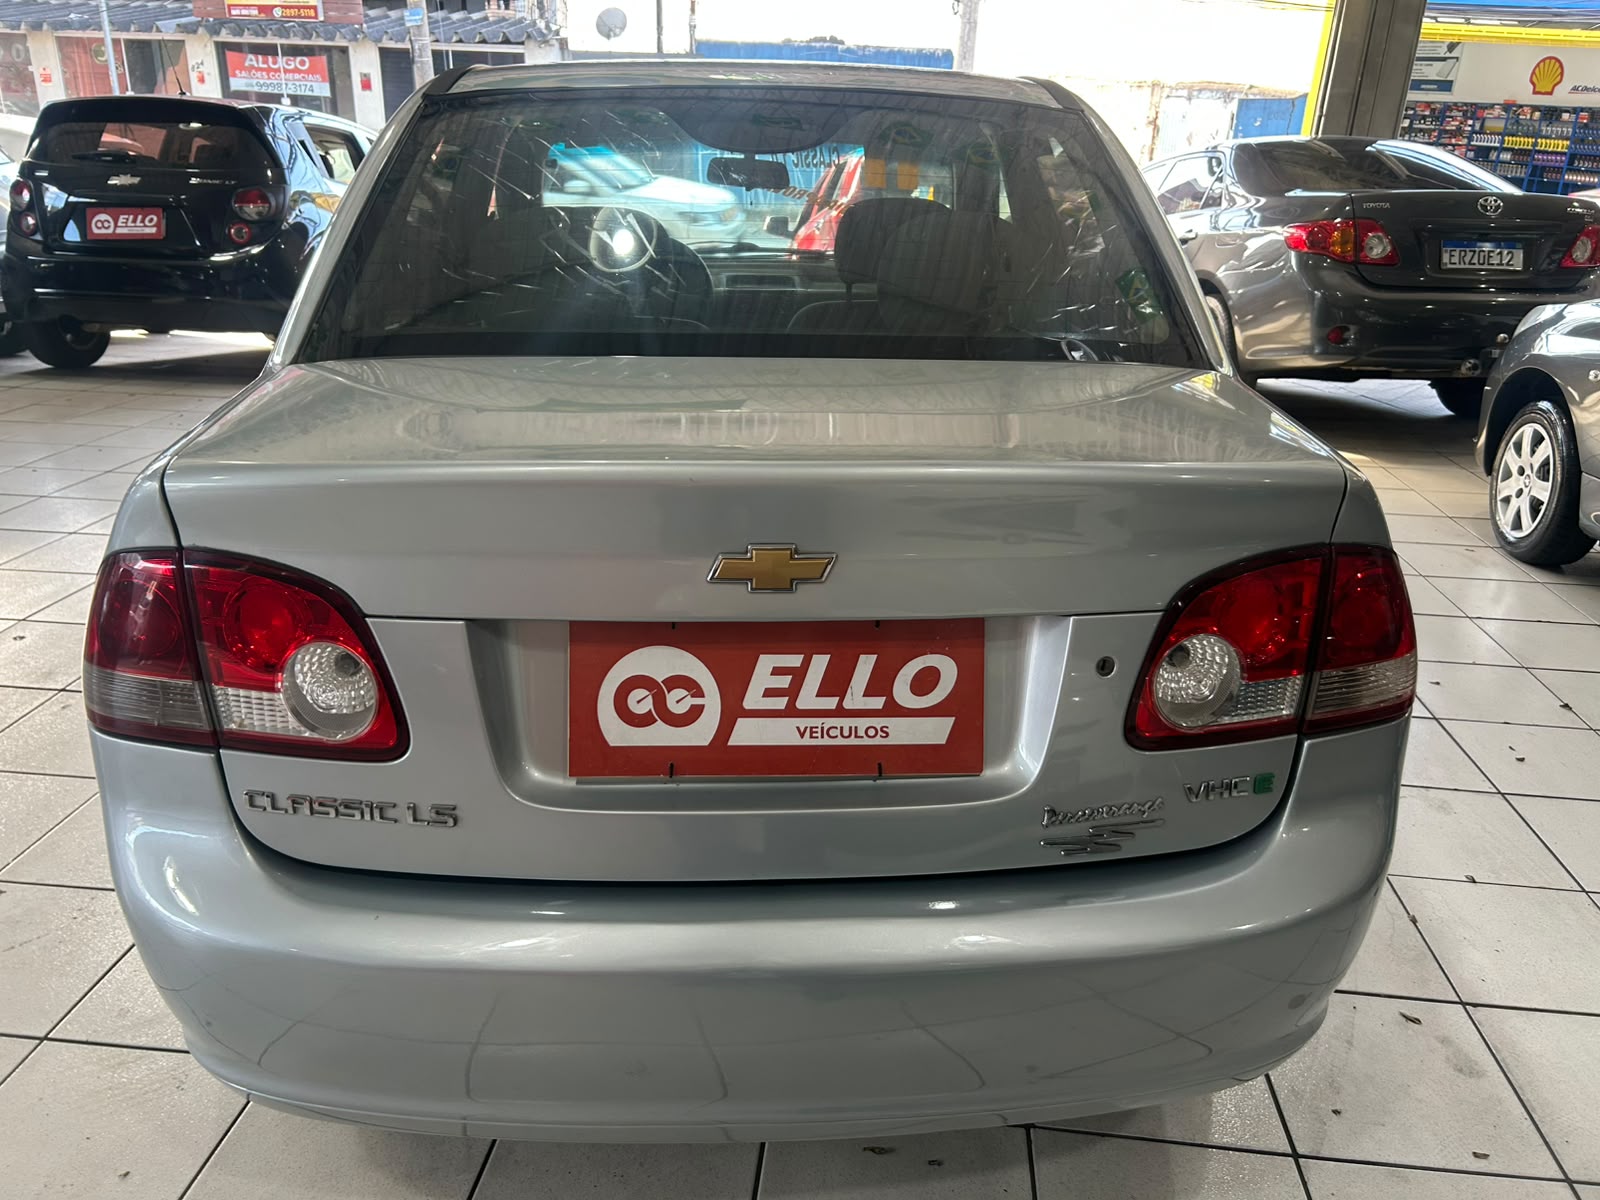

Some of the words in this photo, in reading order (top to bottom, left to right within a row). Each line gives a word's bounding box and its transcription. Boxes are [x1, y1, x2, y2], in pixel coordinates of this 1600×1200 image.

[245, 54, 309, 70] ALUGO
[234, 69, 268, 80] SALÕES
[269, 71, 322, 82] COMERCIAIS
[117, 215, 157, 226] ELLO
[742, 653, 958, 710] ELLO
[796, 723, 890, 740] VEÍCULOS
[243, 789, 399, 824] CLASSIC
[406, 801, 457, 828] LS
